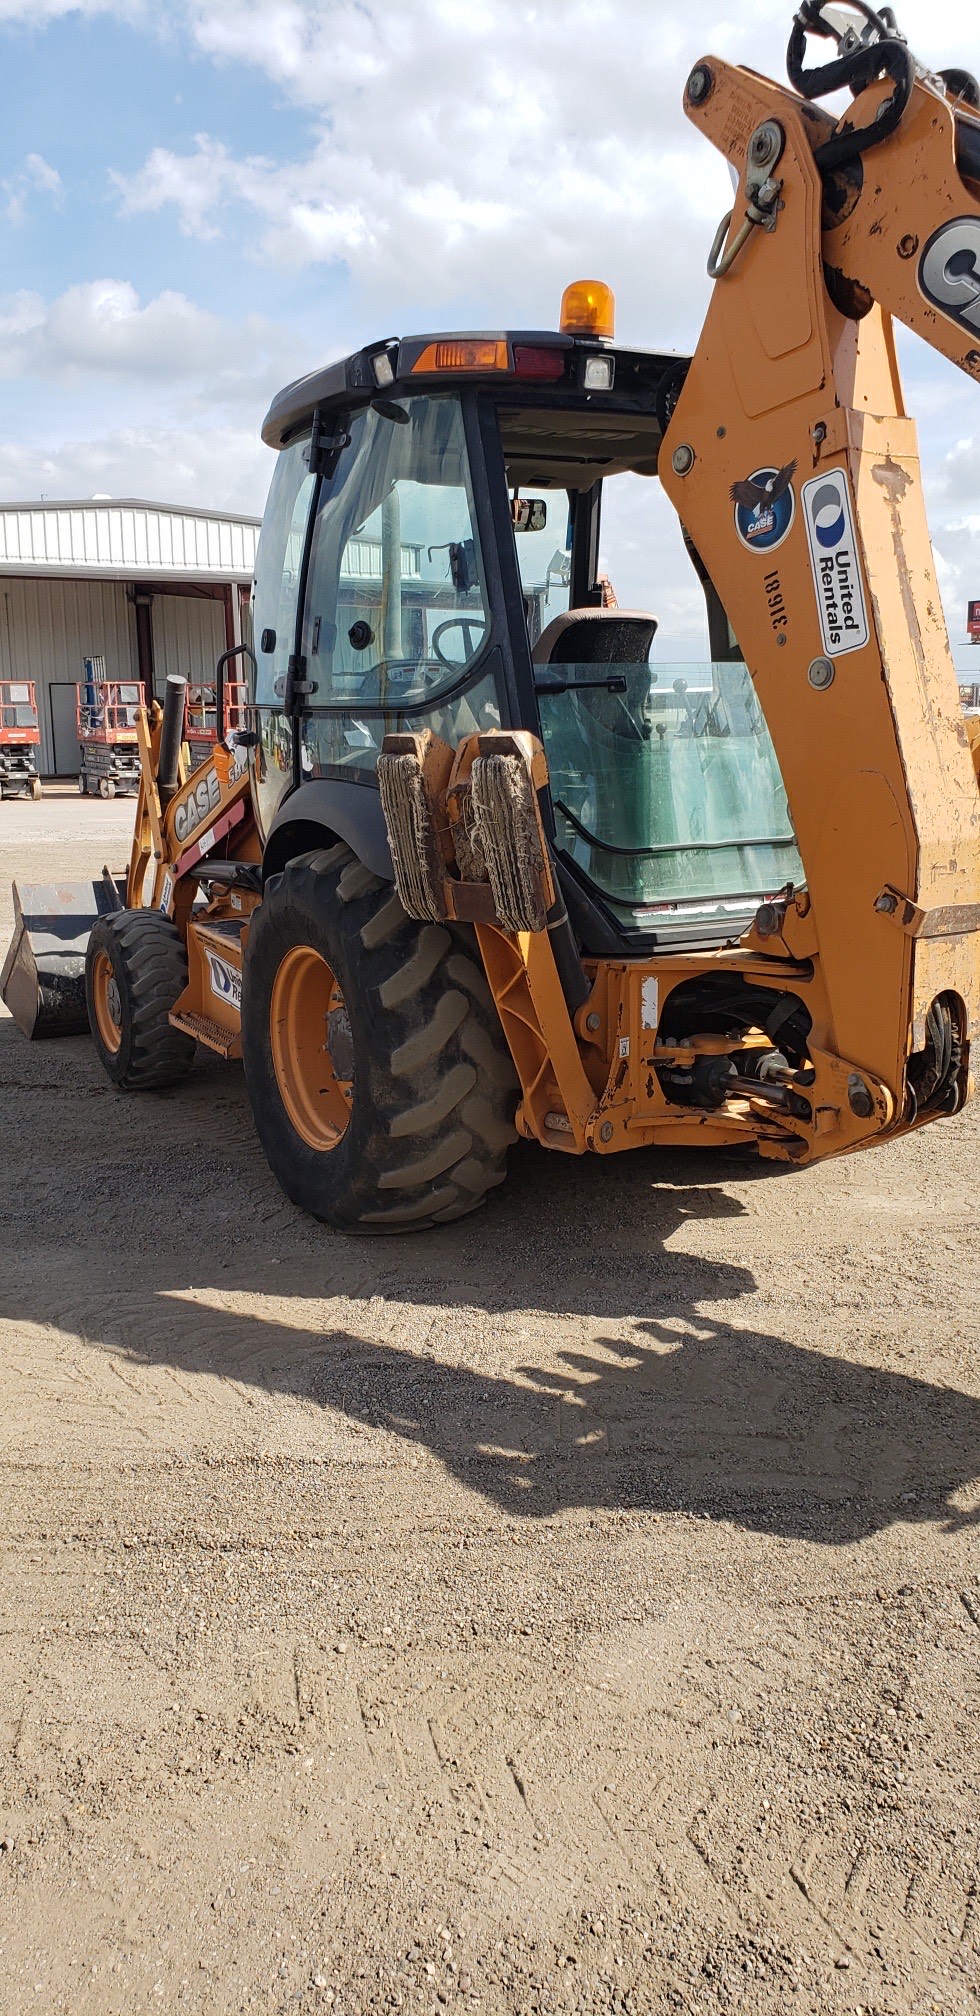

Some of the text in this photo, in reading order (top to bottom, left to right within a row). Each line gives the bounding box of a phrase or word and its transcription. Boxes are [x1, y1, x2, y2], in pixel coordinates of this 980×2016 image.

[747, 515, 774, 532] CASE
[764, 570, 788, 630] 31681
[819, 557, 843, 645] Rentals
[835, 551, 859, 631] United
[174, 766, 221, 841] CASE
